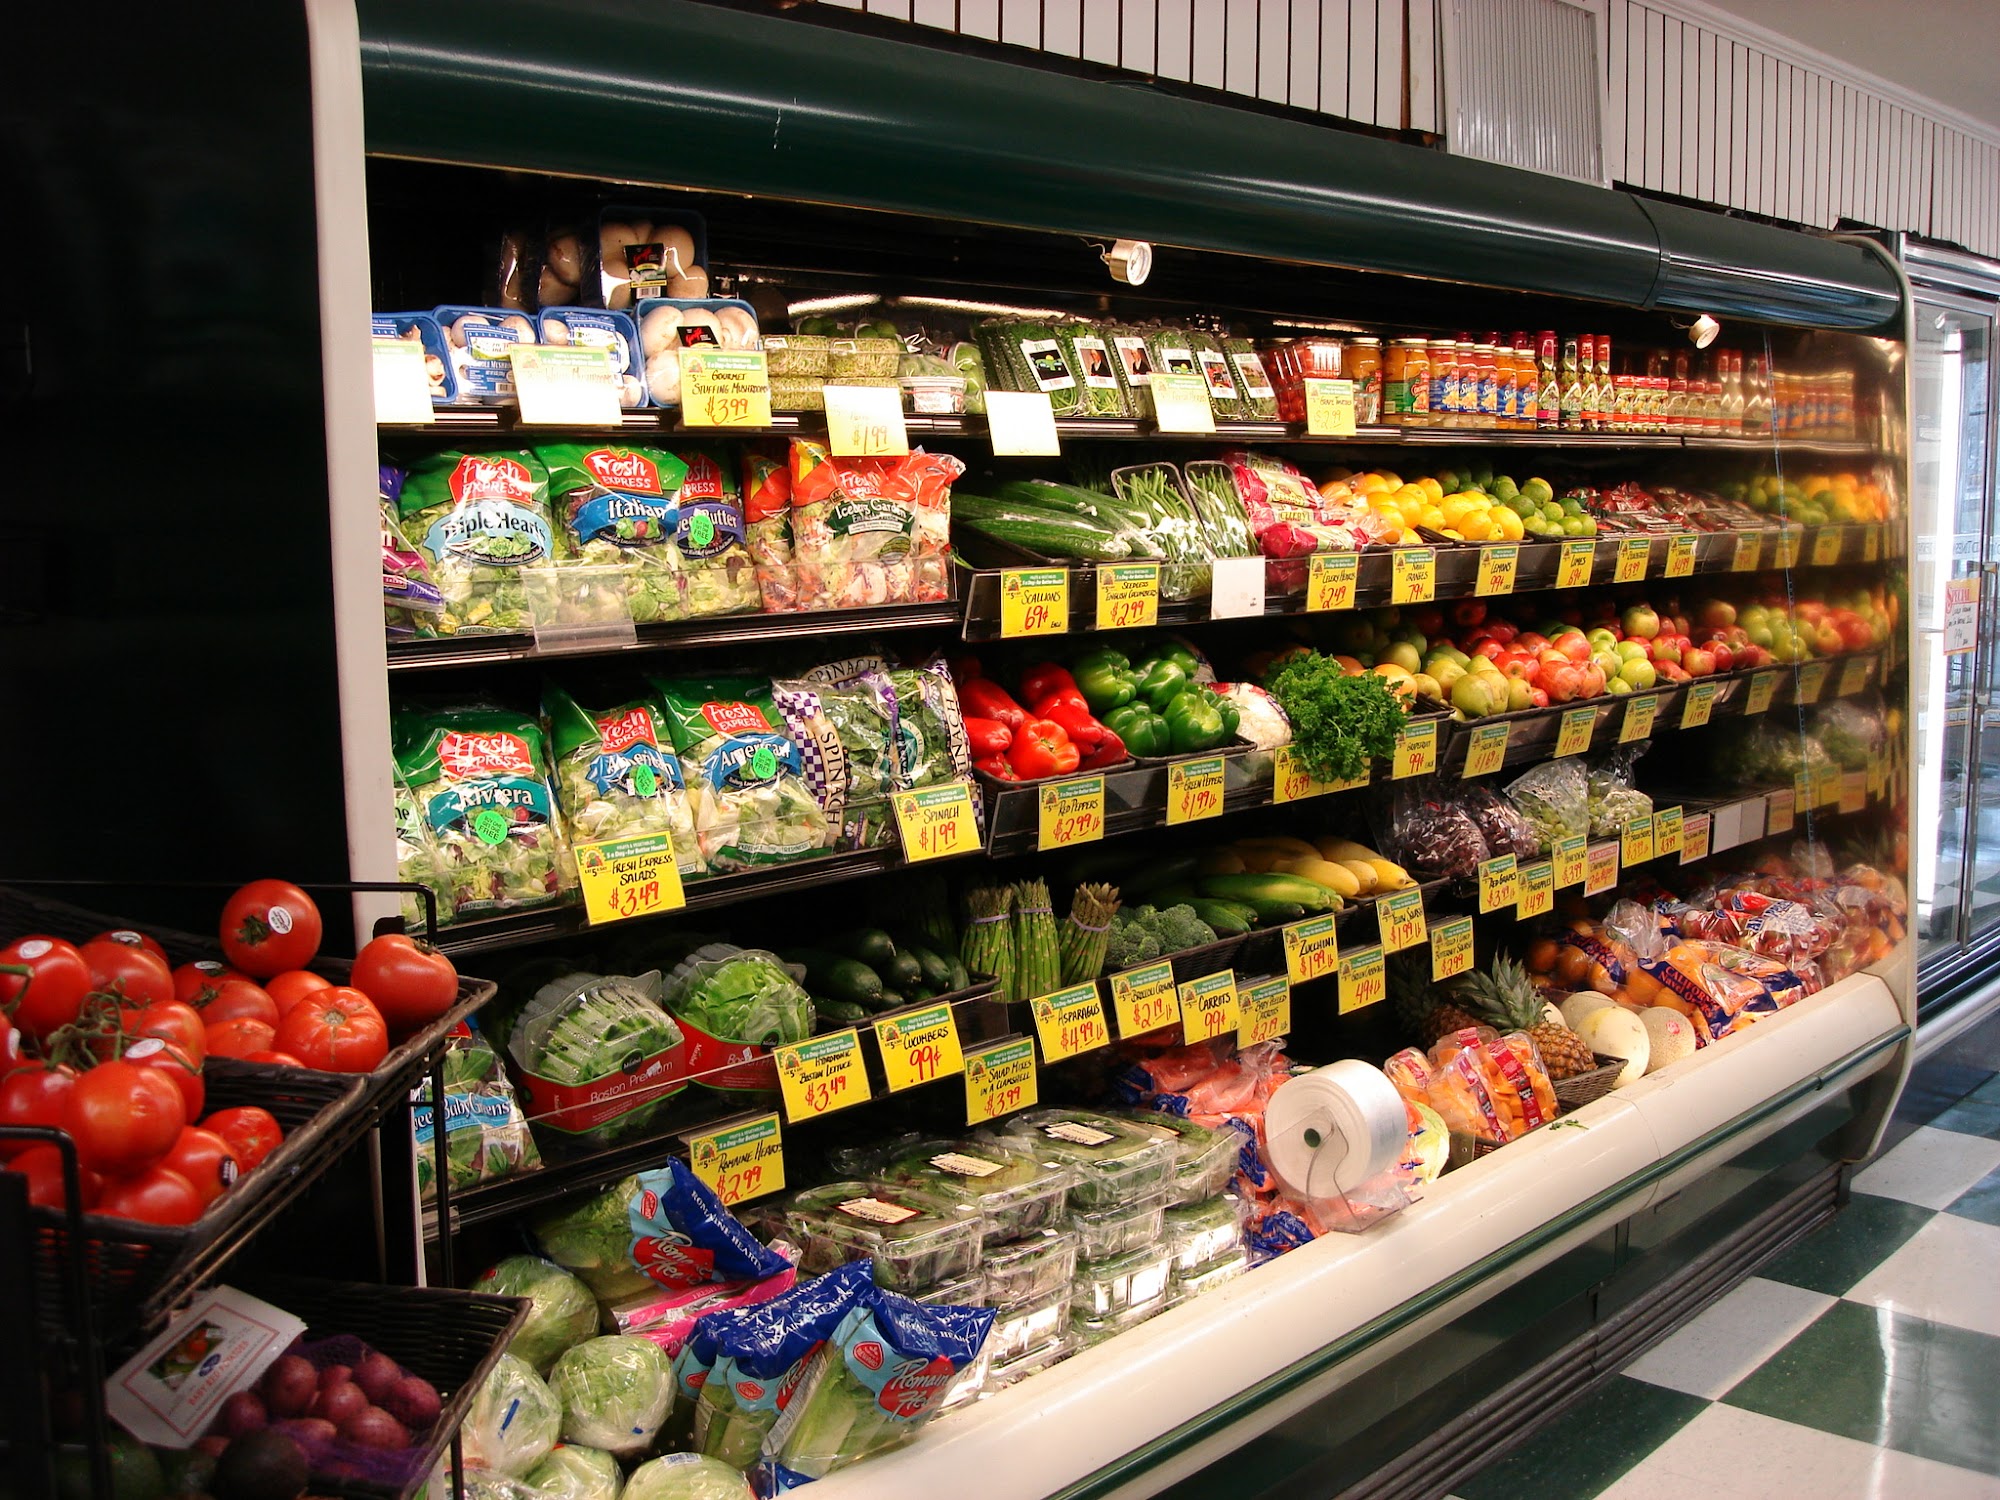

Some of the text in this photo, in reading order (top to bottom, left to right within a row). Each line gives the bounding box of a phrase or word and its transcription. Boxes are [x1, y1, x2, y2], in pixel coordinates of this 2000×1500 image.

[712, 370, 746, 381] GOURMET
[692, 382, 770, 395] STUFFING MUSHROOMS
[705, 396, 748, 426] $3.99
[852, 426, 890, 455] $1.99
[462, 458, 521, 483] Fresh
[591, 454, 647, 477] Fresh
[462, 482, 523, 496] EXPRESS
[602, 476, 652, 489] EXPRESS
[609, 499, 666, 520] Italian
[835, 500, 871, 520] Iceberg
[870, 499, 906, 518] Garden
[499, 514, 546, 540] Hearts
[694, 530, 709, 540] FREE
[1491, 561, 1512, 574] LEMONS
[1571, 555, 1586, 567] LIMES
[1122, 581, 1149, 590] SEEDLESS
[1406, 571, 1428, 581] ORANGES
[1021, 590, 1061, 605] SCALLIONS
[1106, 590, 1157, 601] ENGLISH CUCUMBERS
[1319, 585, 1346, 609] $2.49
[1945, 587, 1970, 614] SPECIAL
[1110, 600, 1144, 626] $2.99
[807, 659, 878, 683] SPINACH
[707, 704, 756, 723] Fresh
[718, 718, 762, 730] EXPRESS
[453, 734, 519, 760] Fresh
[603, 725, 648, 749] EXPRESS
[455, 755, 521, 772] EXPRESS
[721, 741, 791, 771] American
[756, 763, 770, 774] FREE
[821, 731, 841, 826] SPINACH
[1184, 773, 1223, 791] GREEN PEPPERS
[1284, 775, 1310, 800] $3.99
[452, 786, 534, 811] Riviera
[1058, 798, 1098, 816] RED PEPPERS
[1182, 791, 1209, 819] $1.99
[924, 805, 959, 824] SPINACH
[479, 825, 500, 840] FREE
[919, 822, 957, 853] $1.99
[1053, 813, 1091, 843] $2.99
[612, 854, 672, 874] FRESH EXPRESS
[1561, 862, 1582, 884] $3.99
[620, 868, 657, 886] SALADS
[609, 881, 660, 917] $3.49
[1487, 885, 1509, 907] $3.99
[1524, 892, 1545, 913] $4.99
[1390, 922, 1413, 949] $1.99
[1299, 937, 1334, 957] ZUCCHINI
[1300, 950, 1325, 978] $1.99
[1441, 953, 1464, 976] $2.99
[1657, 970, 1686, 997] Navel
[1131, 988, 1155, 1003] BROCCOLI
[1198, 992, 1231, 1012] CARROTS
[1255, 1001, 1269, 1012] BABY
[1058, 1003, 1100, 1025] ASPARAGUS
[1133, 998, 1163, 1028] $2.19
[1255, 1007, 1279, 1022] CARROTS
[903, 1027, 949, 1050] CUCUMBERS
[1060, 1021, 1093, 1053] $4.99
[1251, 1017, 1278, 1041] $2.19
[815, 1050, 851, 1067] HYDROPONIC
[799, 1060, 852, 1084] BOSTON LETTUCE
[988, 1060, 1032, 1083] SALAD MIXES
[591, 1082, 626, 1104] Boston
[805, 1075, 846, 1112] $3.49
[980, 1072, 1030, 1096] IN A CLAMSHELL
[443, 1091, 510, 1120] Baby Greens
[984, 1085, 1020, 1117] $3.99
[718, 1151, 753, 1173] ROMAINE
[716, 1165, 762, 1204] $2.99
[691, 1190, 762, 1272] ROMAINE HEARTS
[895, 1318, 938, 1338] ROMAINE
[188, 1340, 250, 1406] BABY RED POTATOES
